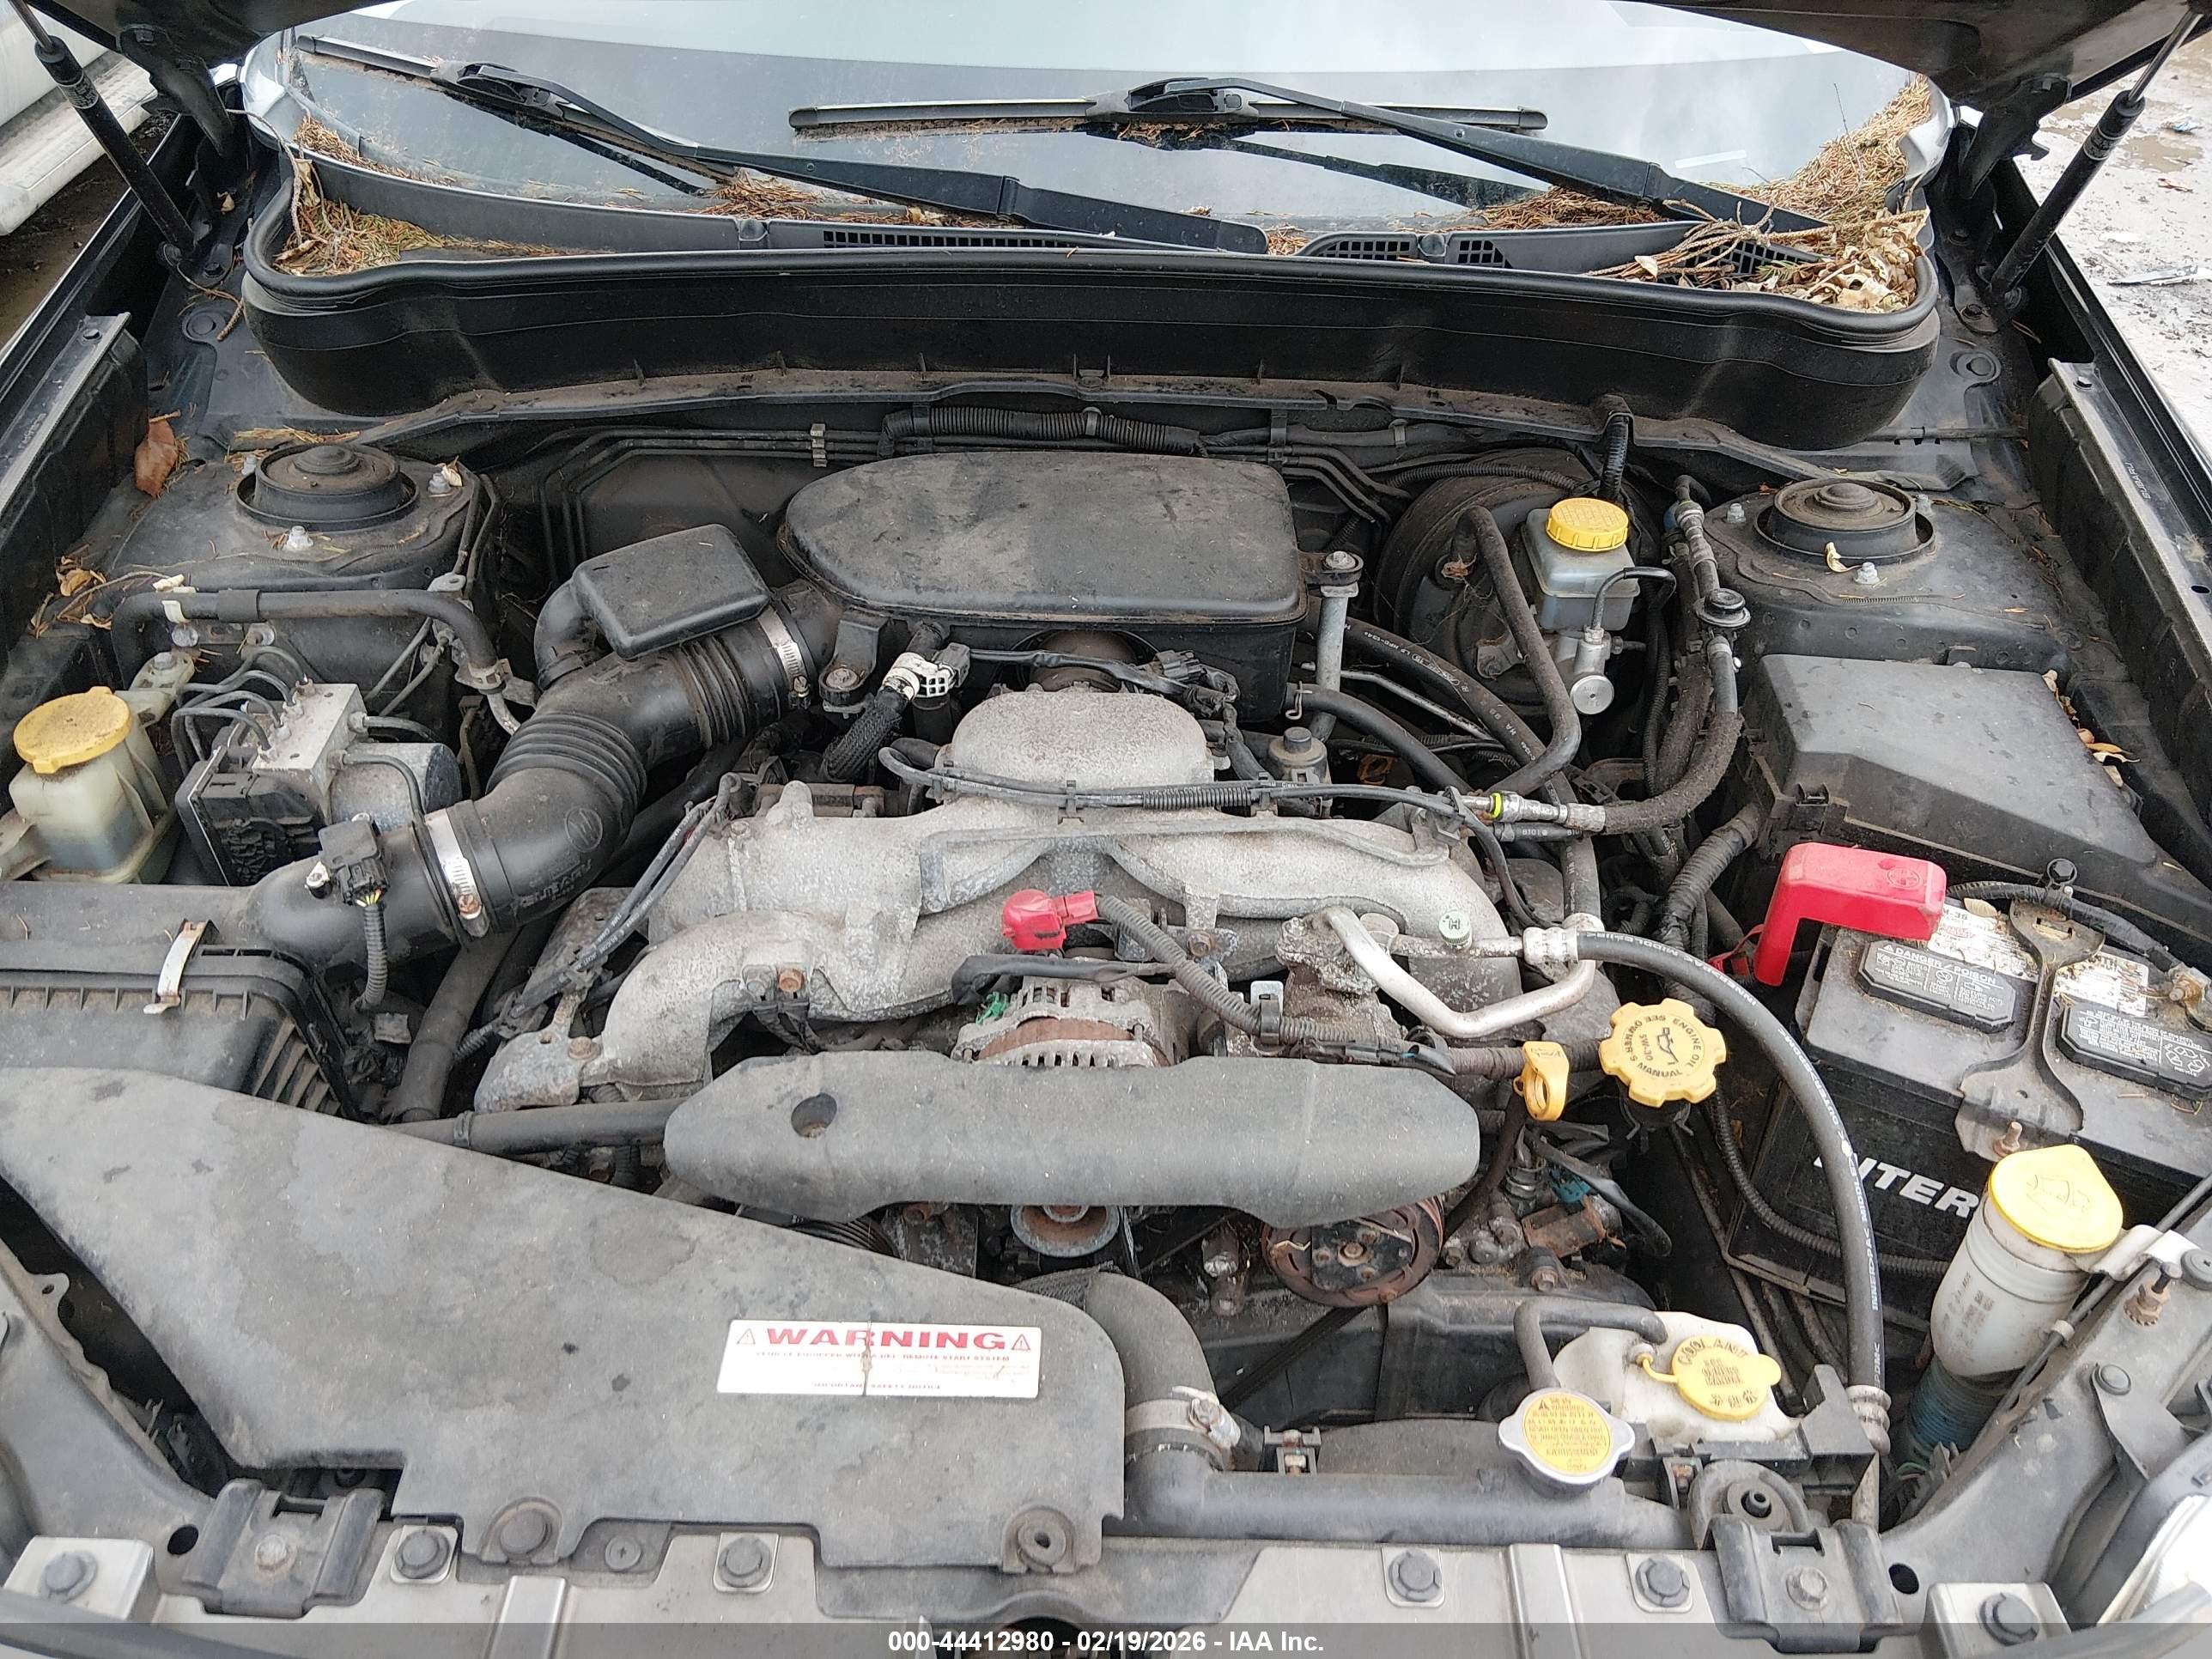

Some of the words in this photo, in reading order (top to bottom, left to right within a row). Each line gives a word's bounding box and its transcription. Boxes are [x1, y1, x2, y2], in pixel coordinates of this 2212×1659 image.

[1449, 918, 1461, 930] H
[1895, 947, 1942, 968] DANGER
[1954, 965, 1996, 985] POISON
[1673, 1018, 1702, 1050] ENGINE
[1637, 1061, 1683, 1079] MANUAL
[1686, 1054, 1700, 1068] OIL
[767, 1328, 1006, 1350] WARNING
[1677, 1338, 1749, 1365] COOLANT
